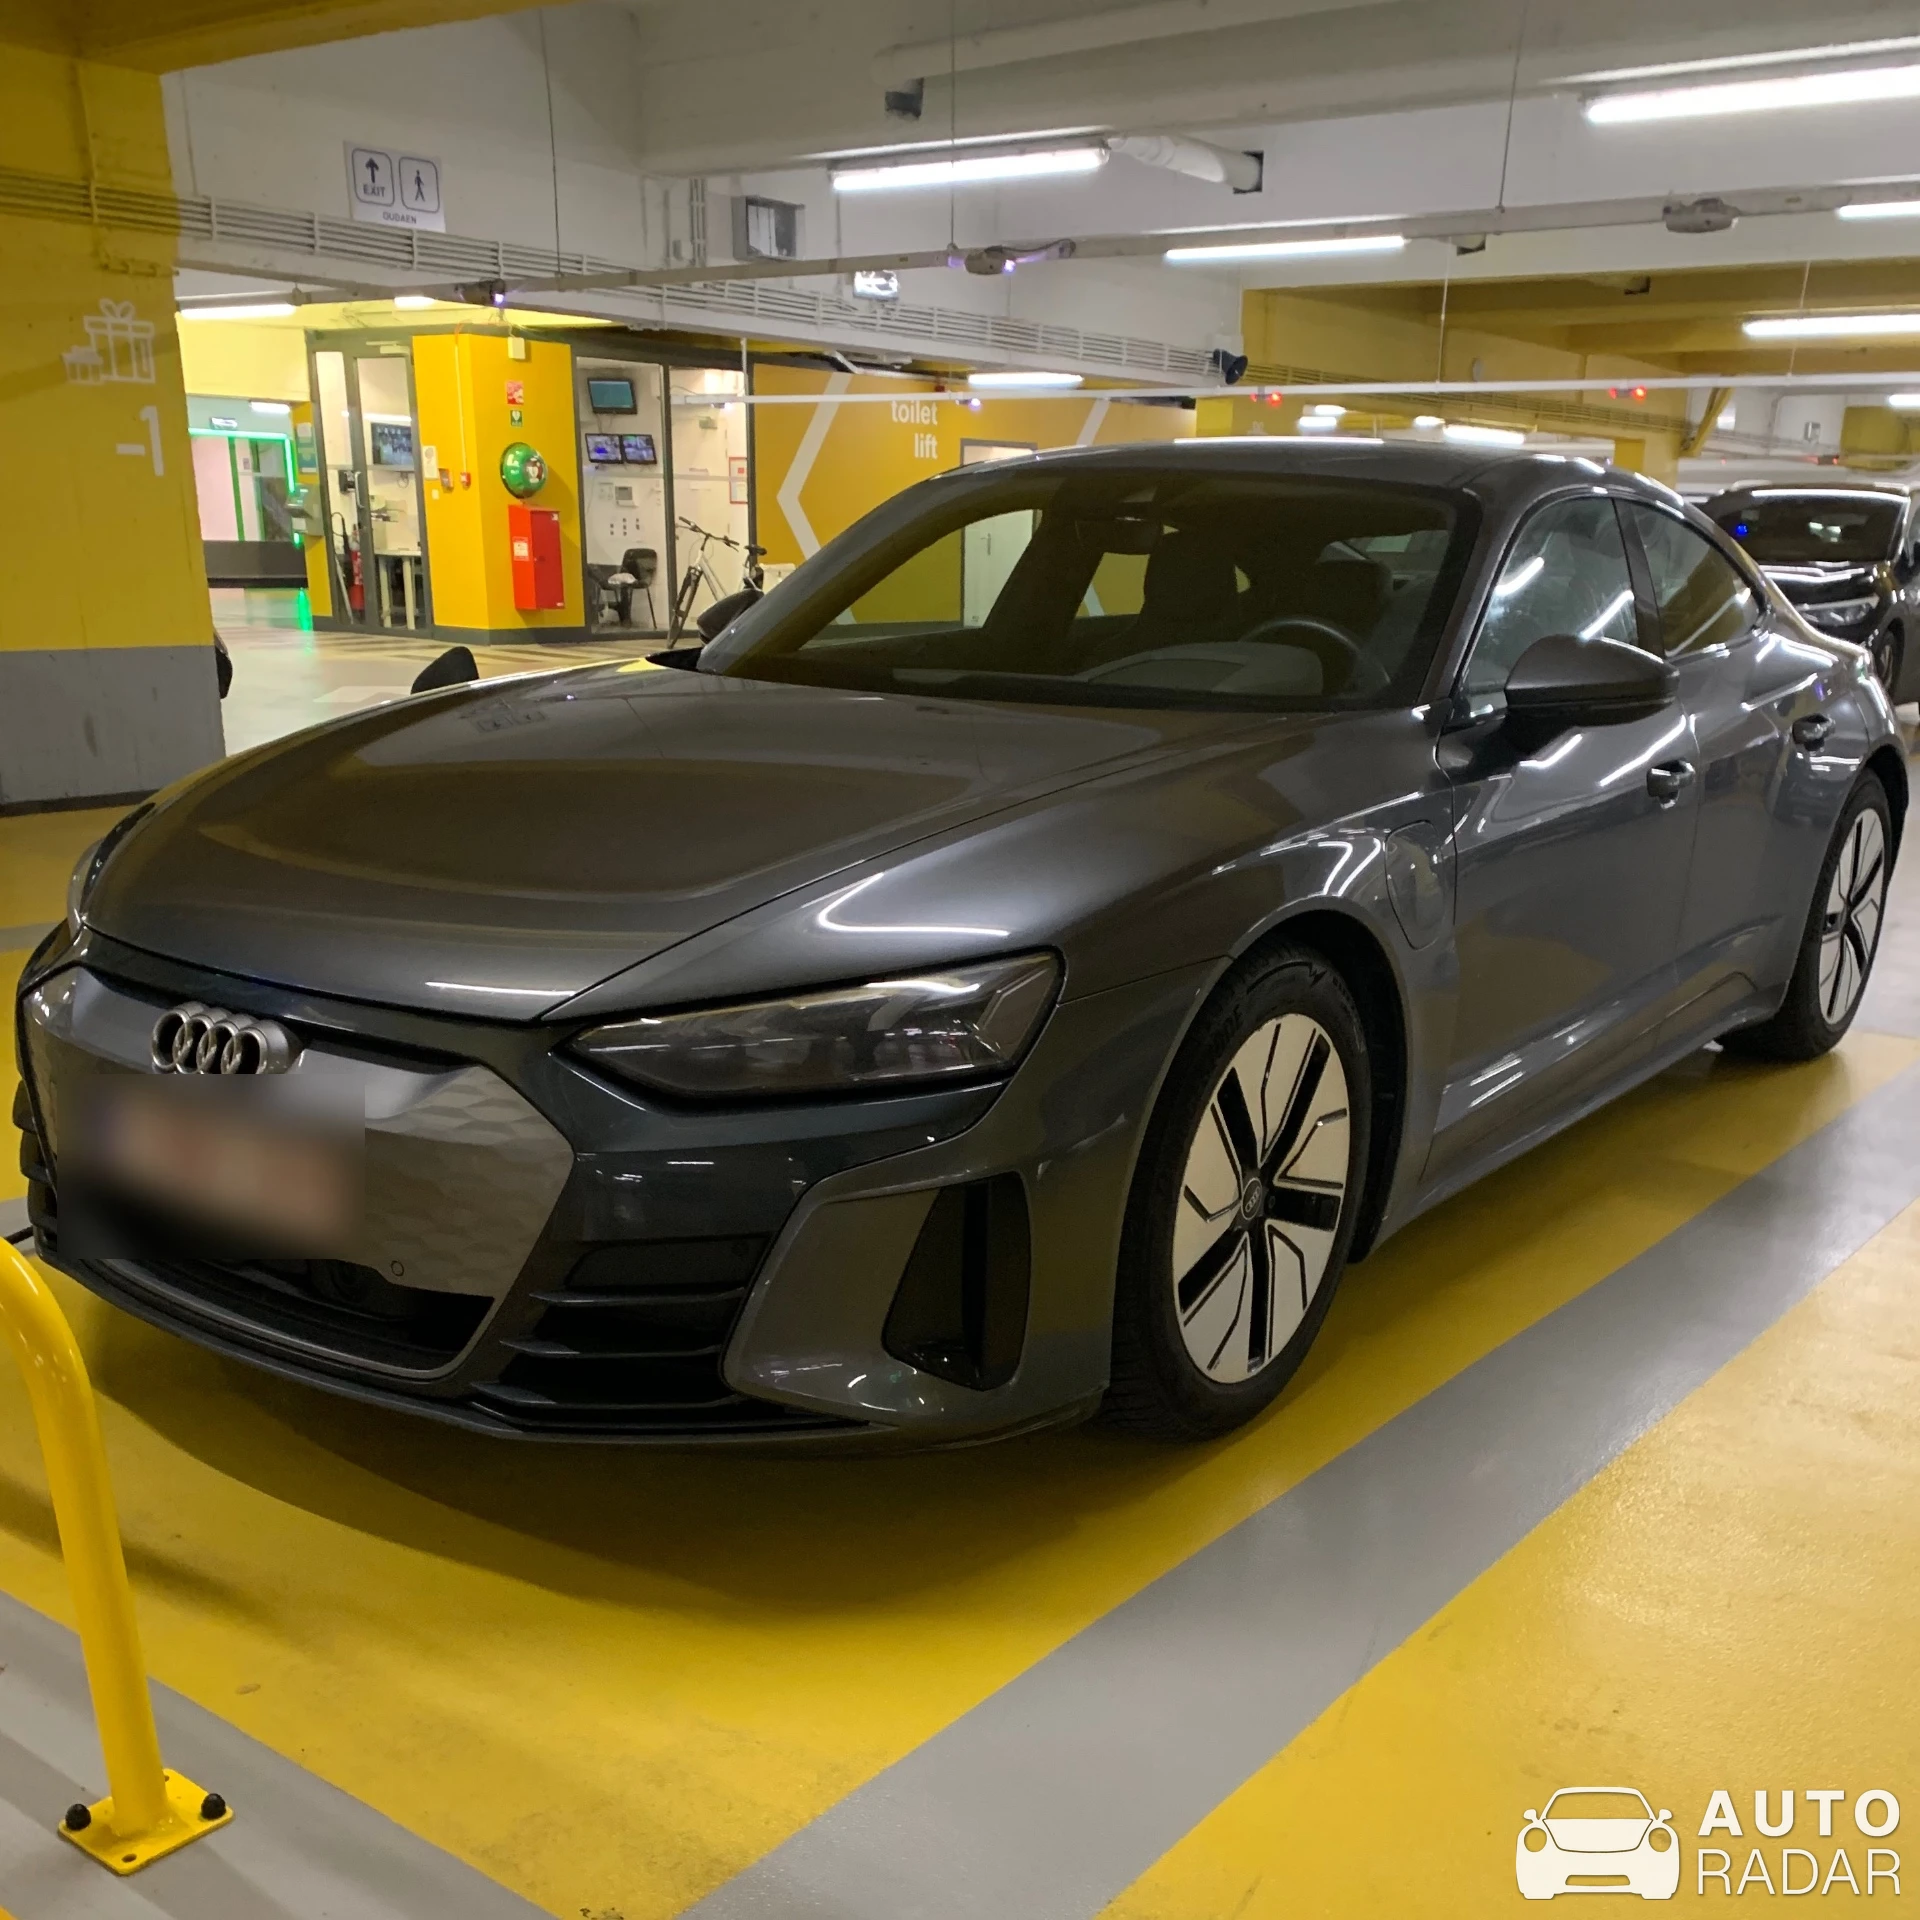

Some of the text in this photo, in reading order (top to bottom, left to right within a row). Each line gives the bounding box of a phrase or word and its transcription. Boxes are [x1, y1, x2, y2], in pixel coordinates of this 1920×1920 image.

[363, 184, 385, 197] EXIT
[891, 400, 938, 426] toilet
[914, 432, 938, 460] lift
